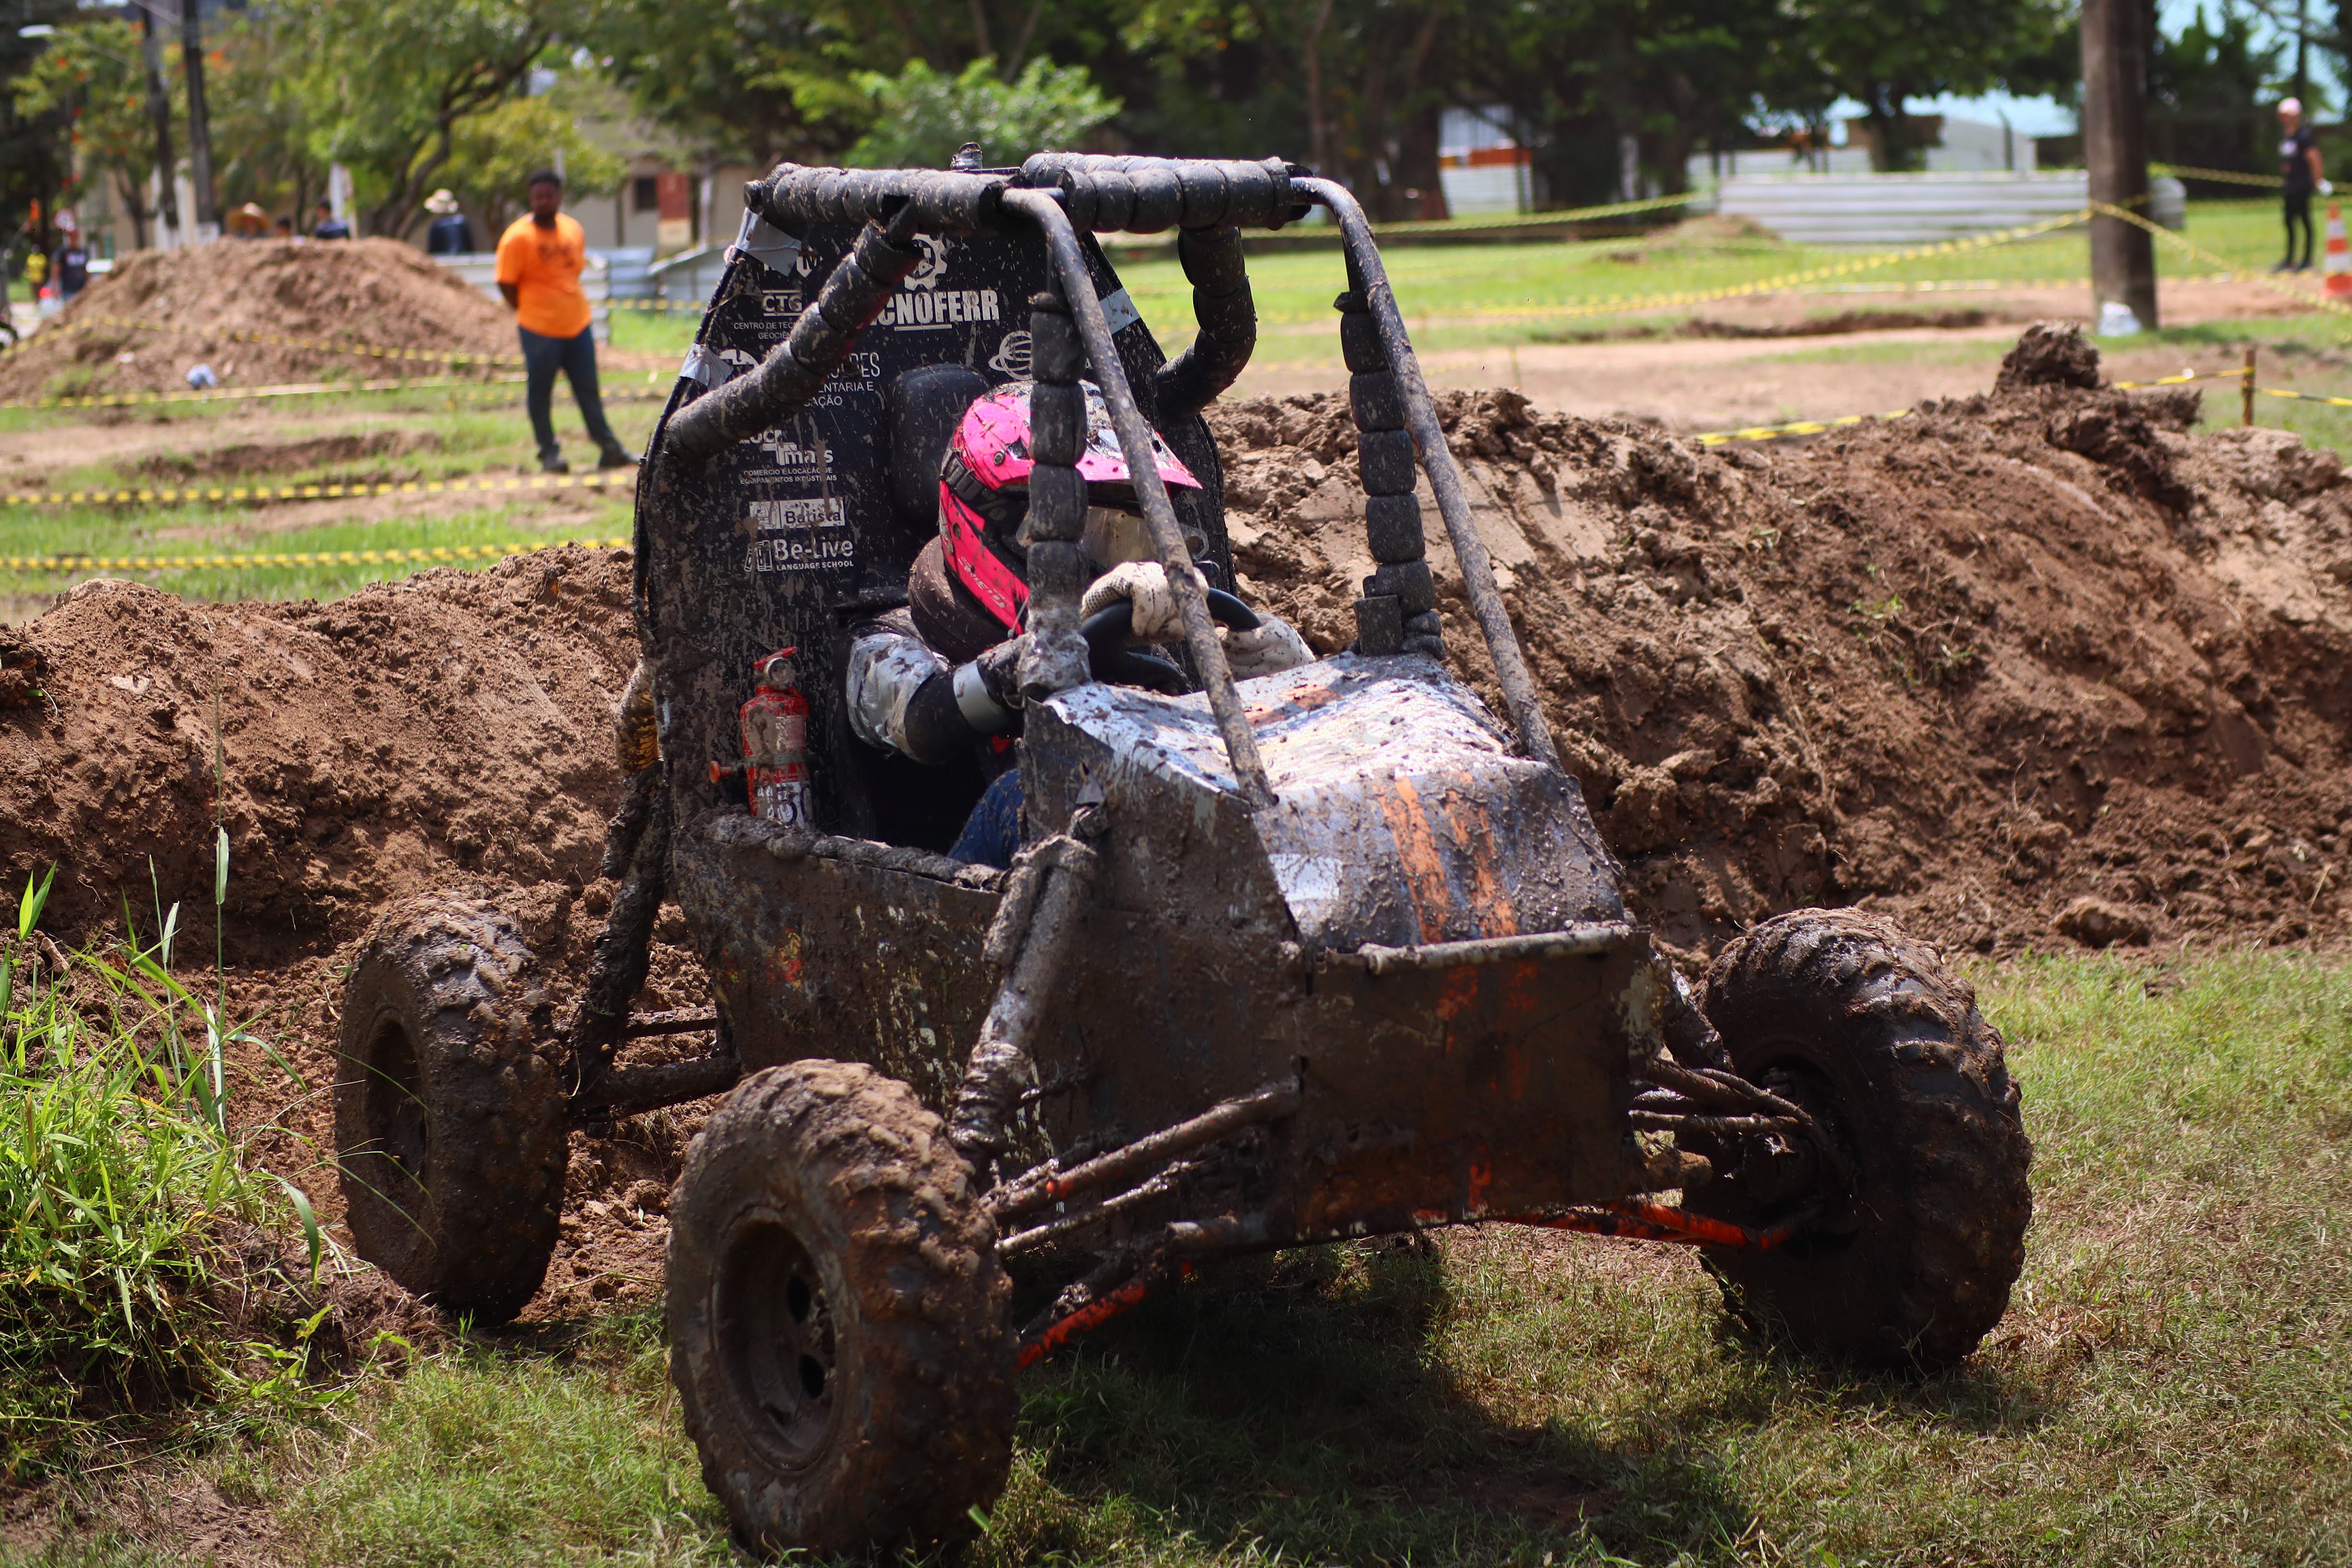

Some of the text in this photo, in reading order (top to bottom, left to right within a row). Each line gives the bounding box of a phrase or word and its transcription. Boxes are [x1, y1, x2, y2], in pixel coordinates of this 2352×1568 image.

[763, 295, 802, 312] CTG
[870, 290, 999, 326] CNOFERR
[819, 381, 874, 393] NTARIA E
[776, 560, 854, 571] LANGUAGE SCHOOL
